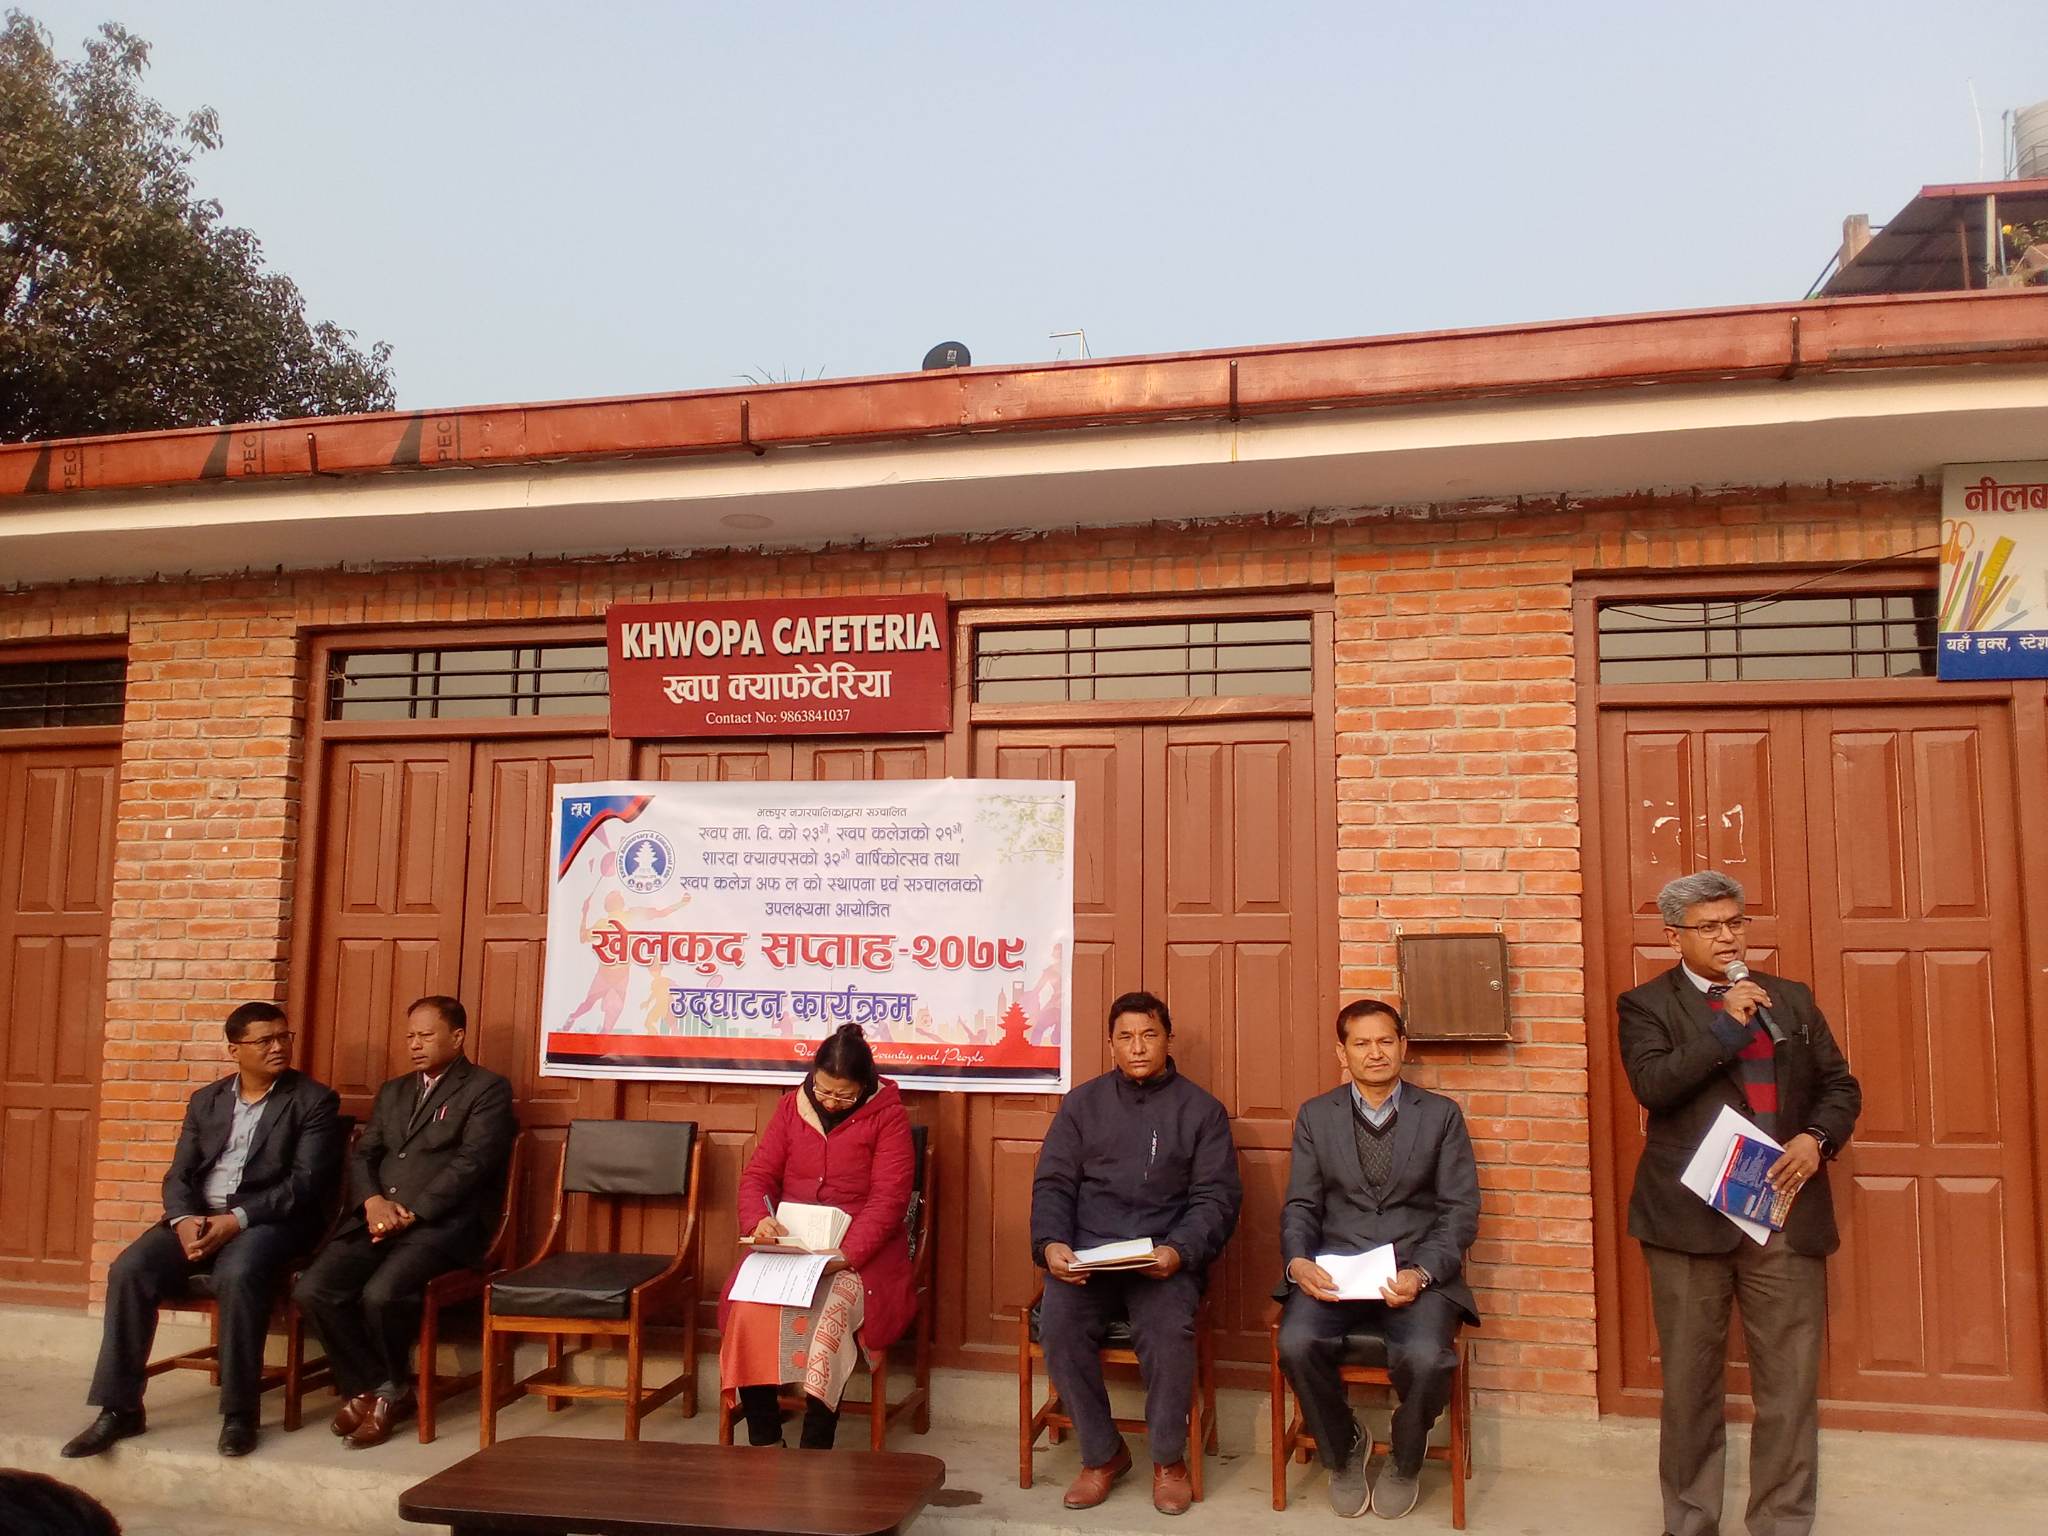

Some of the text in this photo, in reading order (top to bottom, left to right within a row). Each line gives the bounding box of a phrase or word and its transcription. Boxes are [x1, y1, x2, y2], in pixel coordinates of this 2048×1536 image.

[621, 612, 941, 659] KHWOPA CAFETERIA
[1946, 633, 1972, 652] यहाँ
[662, 661, 893, 704] ख्वप क्याफेटेरिया
[706, 709, 850, 725] Contact No: 9863841037
[732, 827, 751, 840] मा.
[756, 824, 772, 840] वि.
[779, 823, 798, 840] को
[871, 823, 931, 840] कलेजको
[702, 851, 739, 866] शारदा
[743, 848, 818, 866] क्याम्पसको
[855, 848, 930, 866] वार्षिकोत्सव
[934, 852, 960, 866] तथा
[713, 872, 752, 890] कलेज
[756, 878, 781, 890] अफ
[803, 873, 822, 891] को
[827, 877, 875, 892] स्थापना
[880, 874, 899, 892] एवं
[904, 874, 983, 892] सञ्चालनको
[765, 899, 892, 917] उपलक्ष्यमा आयोजित
[591, 920, 1026, 974] खेलकुद सप्ताह-२०७९
[669, 985, 917, 1027] उद्घाटन कार्यक्रम
[916, 1050, 939, 1062] and
[942, 1047, 985, 1066] People
